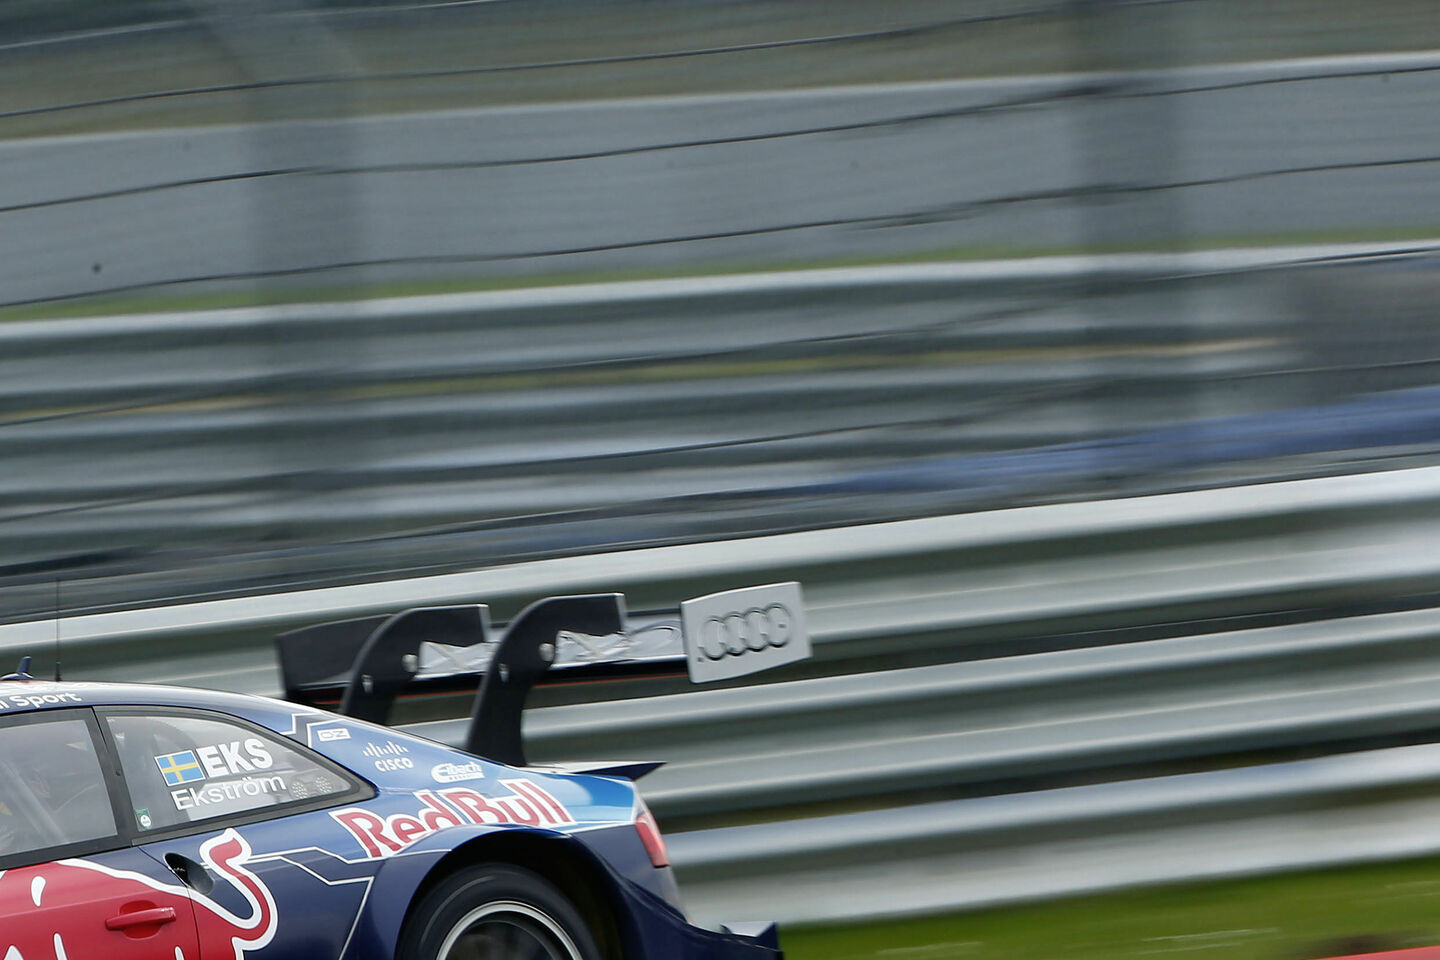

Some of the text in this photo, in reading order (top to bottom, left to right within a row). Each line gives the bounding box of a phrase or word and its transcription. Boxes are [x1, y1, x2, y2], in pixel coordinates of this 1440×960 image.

[10, 691, 82, 709] Sport
[196, 738, 274, 778] EKS
[171, 776, 287, 811] Ekström
[328, 779, 577, 858] Red Bull
